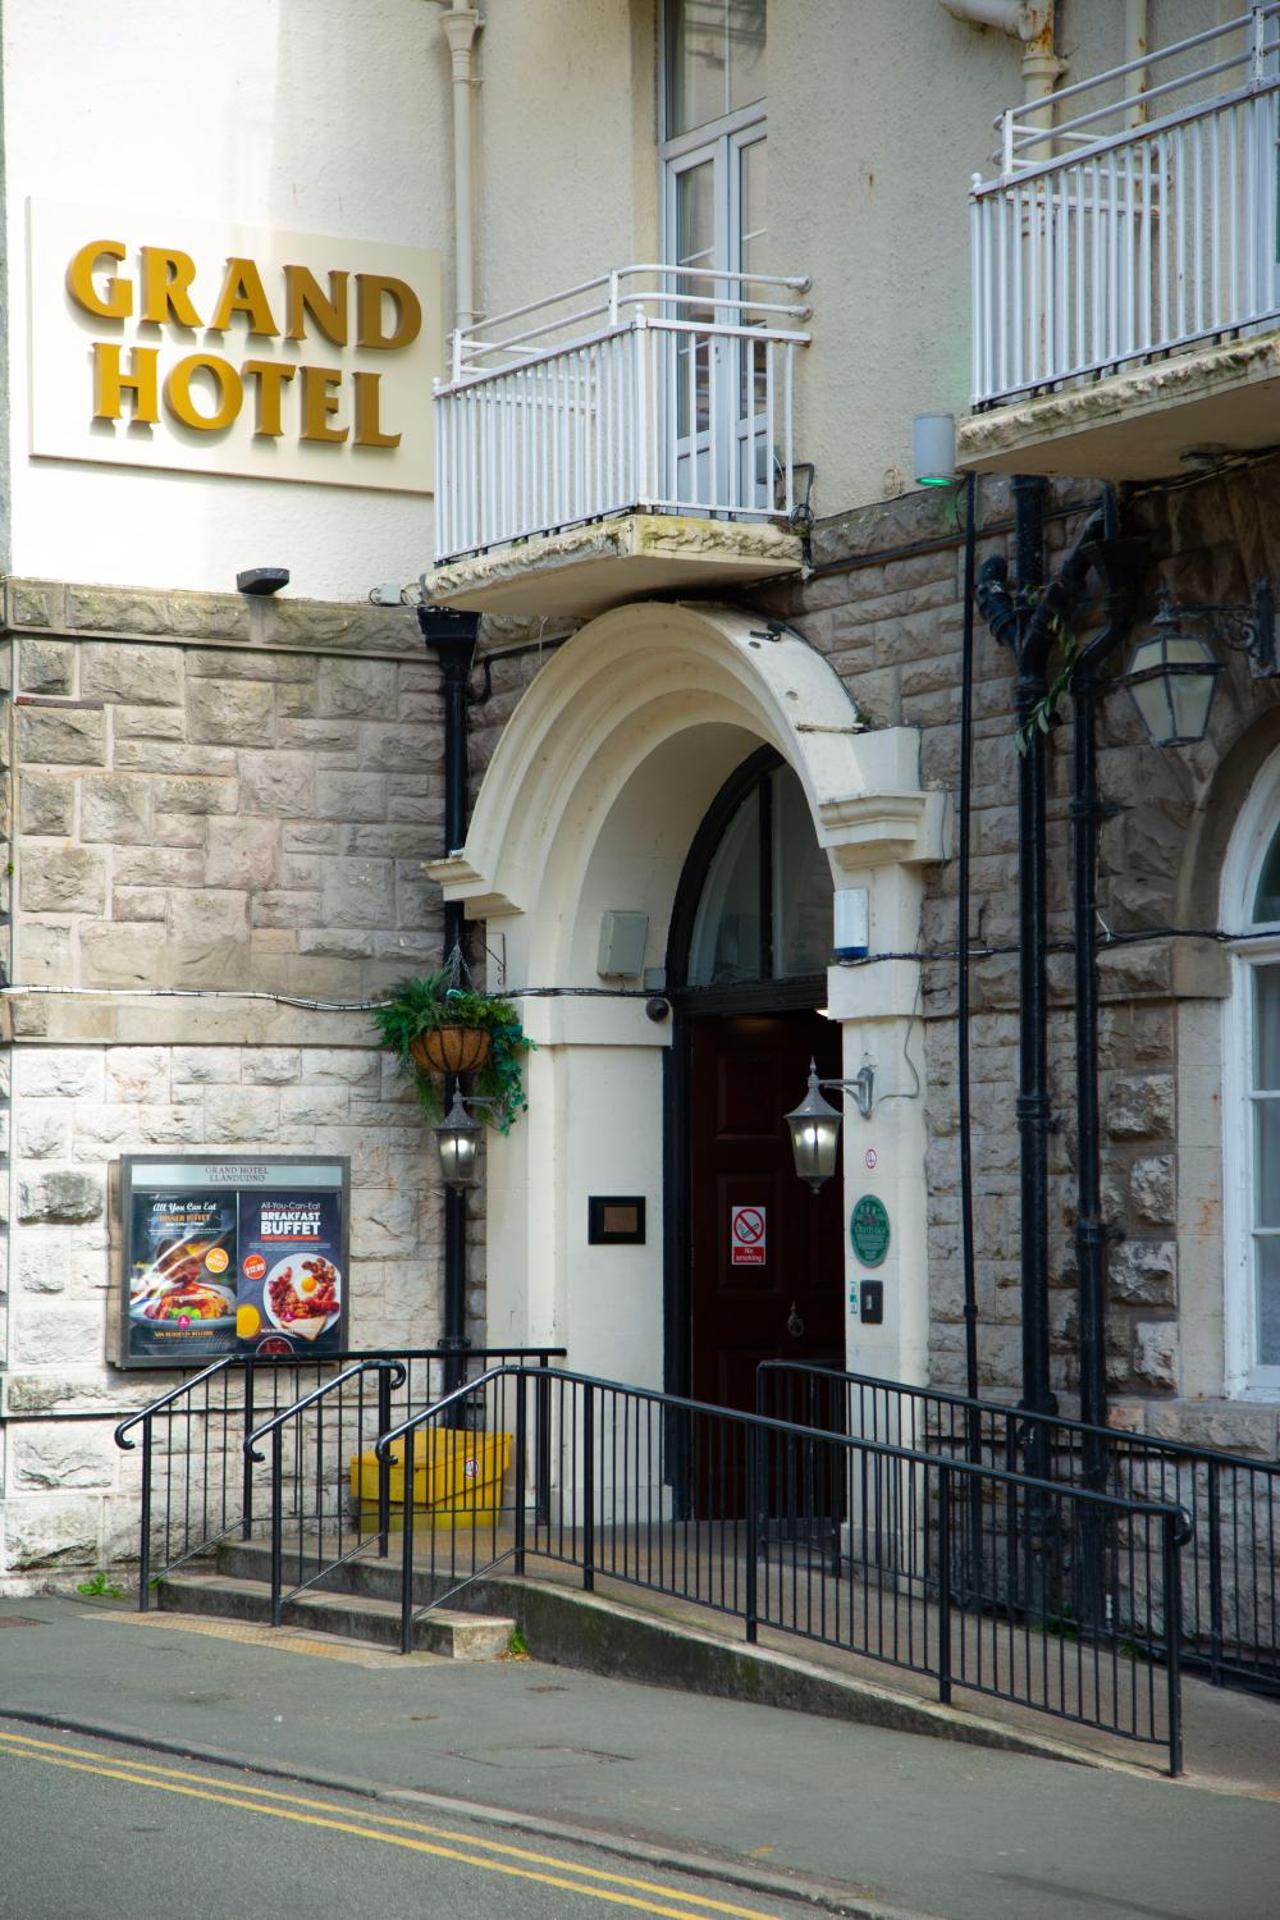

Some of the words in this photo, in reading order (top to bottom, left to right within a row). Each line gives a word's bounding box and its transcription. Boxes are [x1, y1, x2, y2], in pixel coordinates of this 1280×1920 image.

[66, 239, 422, 350] GRAND
[92, 342, 402, 448] HOTEL
[205, 1166, 237, 1175] GRAND
[240, 1166, 269, 1175] HOTEL
[209, 1174, 266, 1182] LLANDUDNO
[168, 1202, 185, 1214] You
[261, 1211, 321, 1221] BREAKFAST
[260, 1221, 322, 1235] BUFFET
